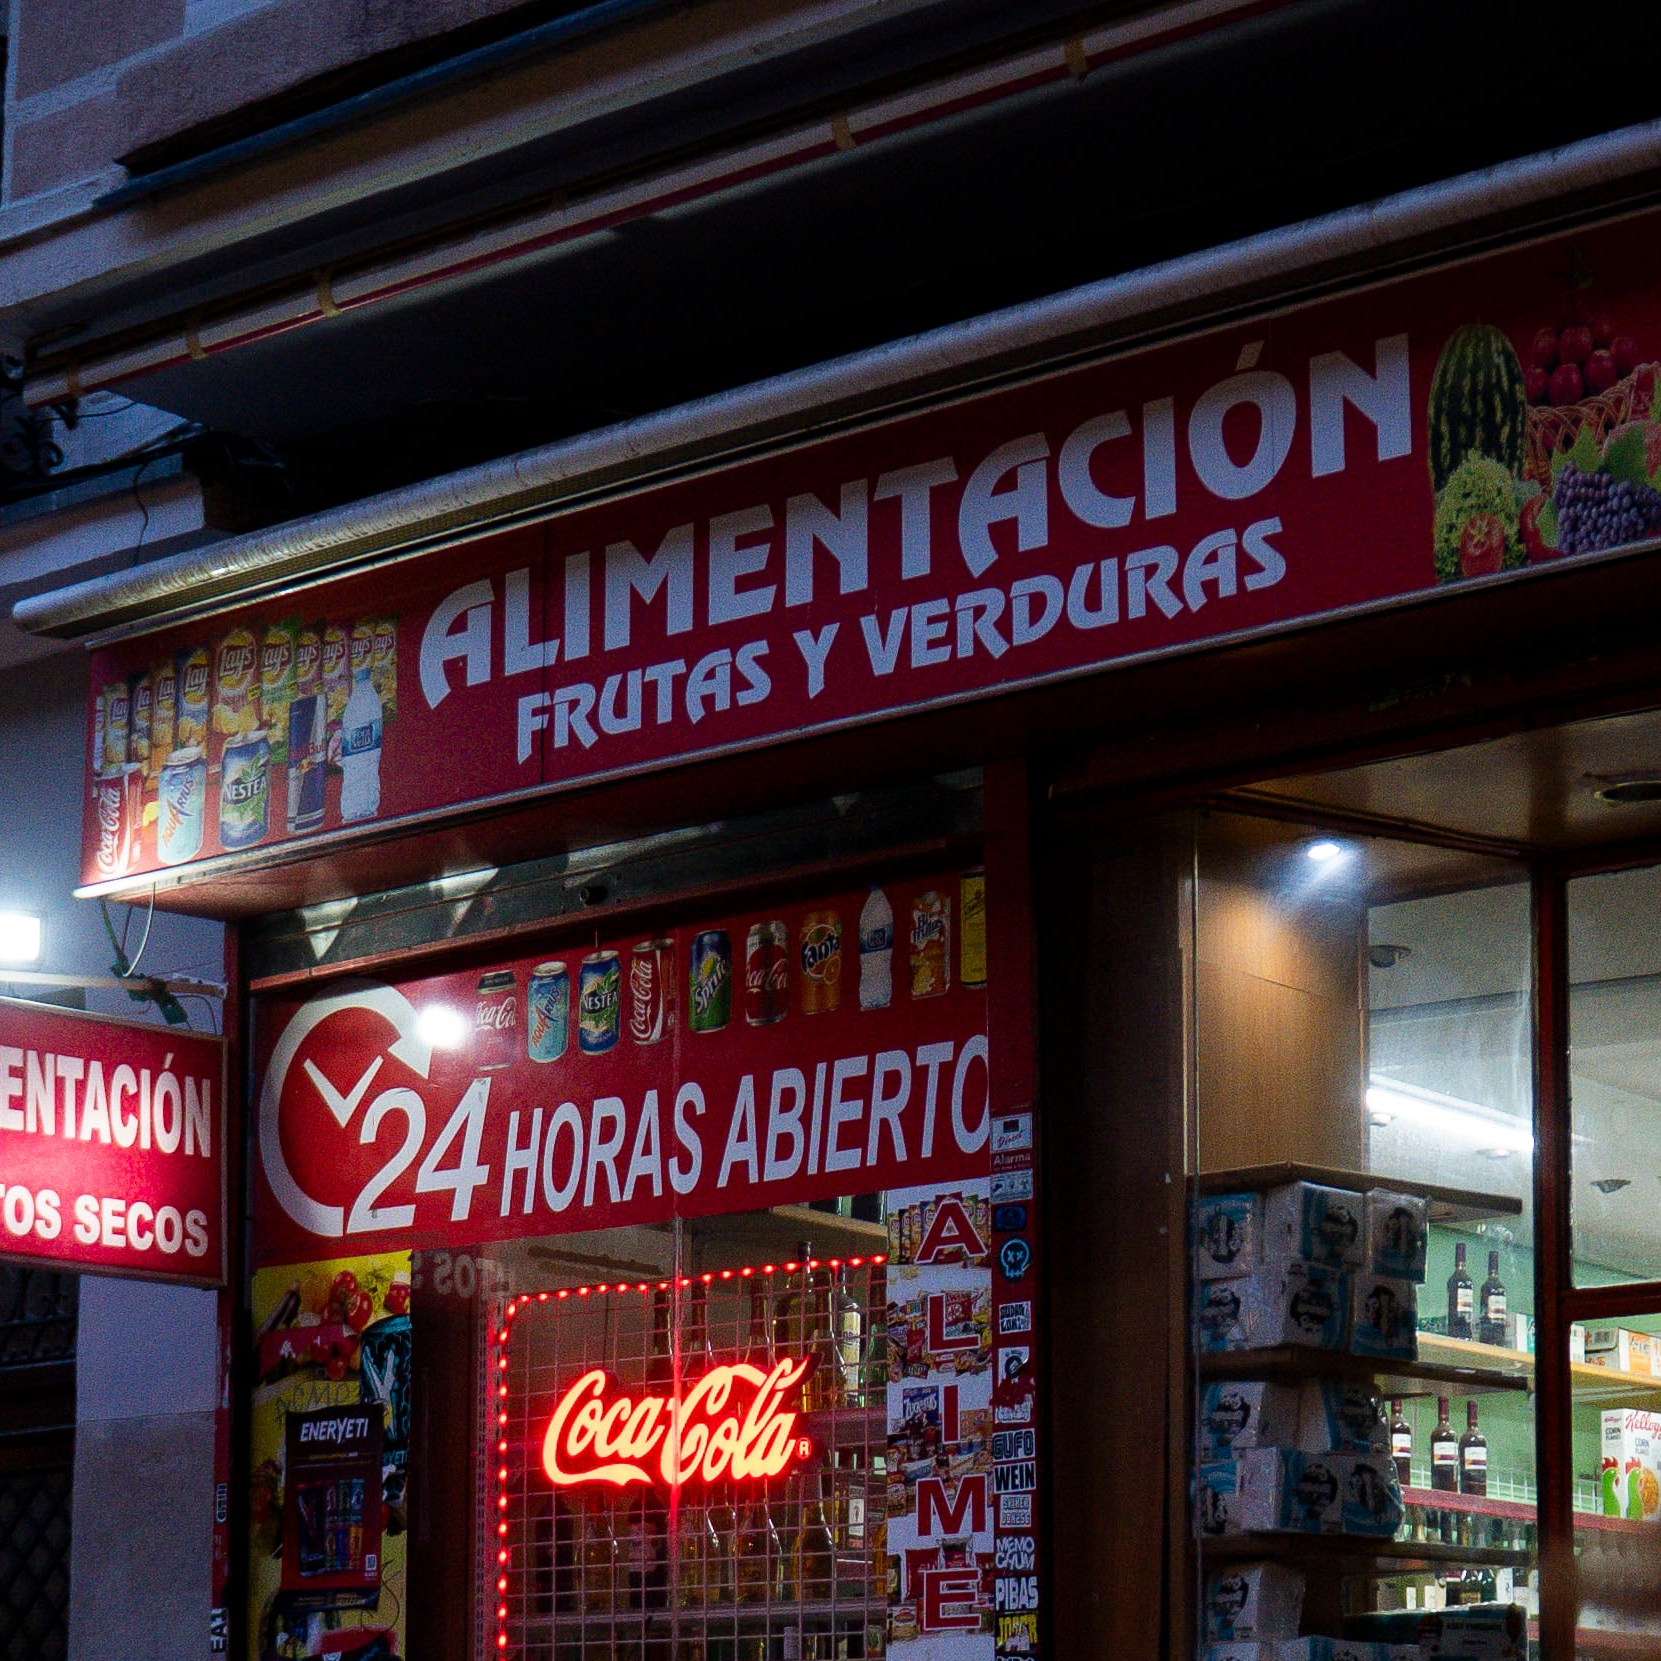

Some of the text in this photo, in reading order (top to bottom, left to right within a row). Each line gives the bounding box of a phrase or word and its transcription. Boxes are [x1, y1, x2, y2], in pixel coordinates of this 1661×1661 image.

[419, 334, 1412, 709] ALIMENTACIÓN
[516, 517, 1287, 765] FRUTAS Y VERDURAS
[223, 777, 267, 804] NESTEA
[342, 1033, 989, 1237] 24 HORAS ABIERTO
[73, 1195, 208, 1258] SECOS
[299, 1416, 370, 1445] ENERYETI
[541, 1355, 809, 1488] Coca-Cola
[993, 1432, 1034, 1459] GUFO
[995, 1464, 1035, 1491] WEIN
[994, 1576, 1039, 1611] PIBAS
